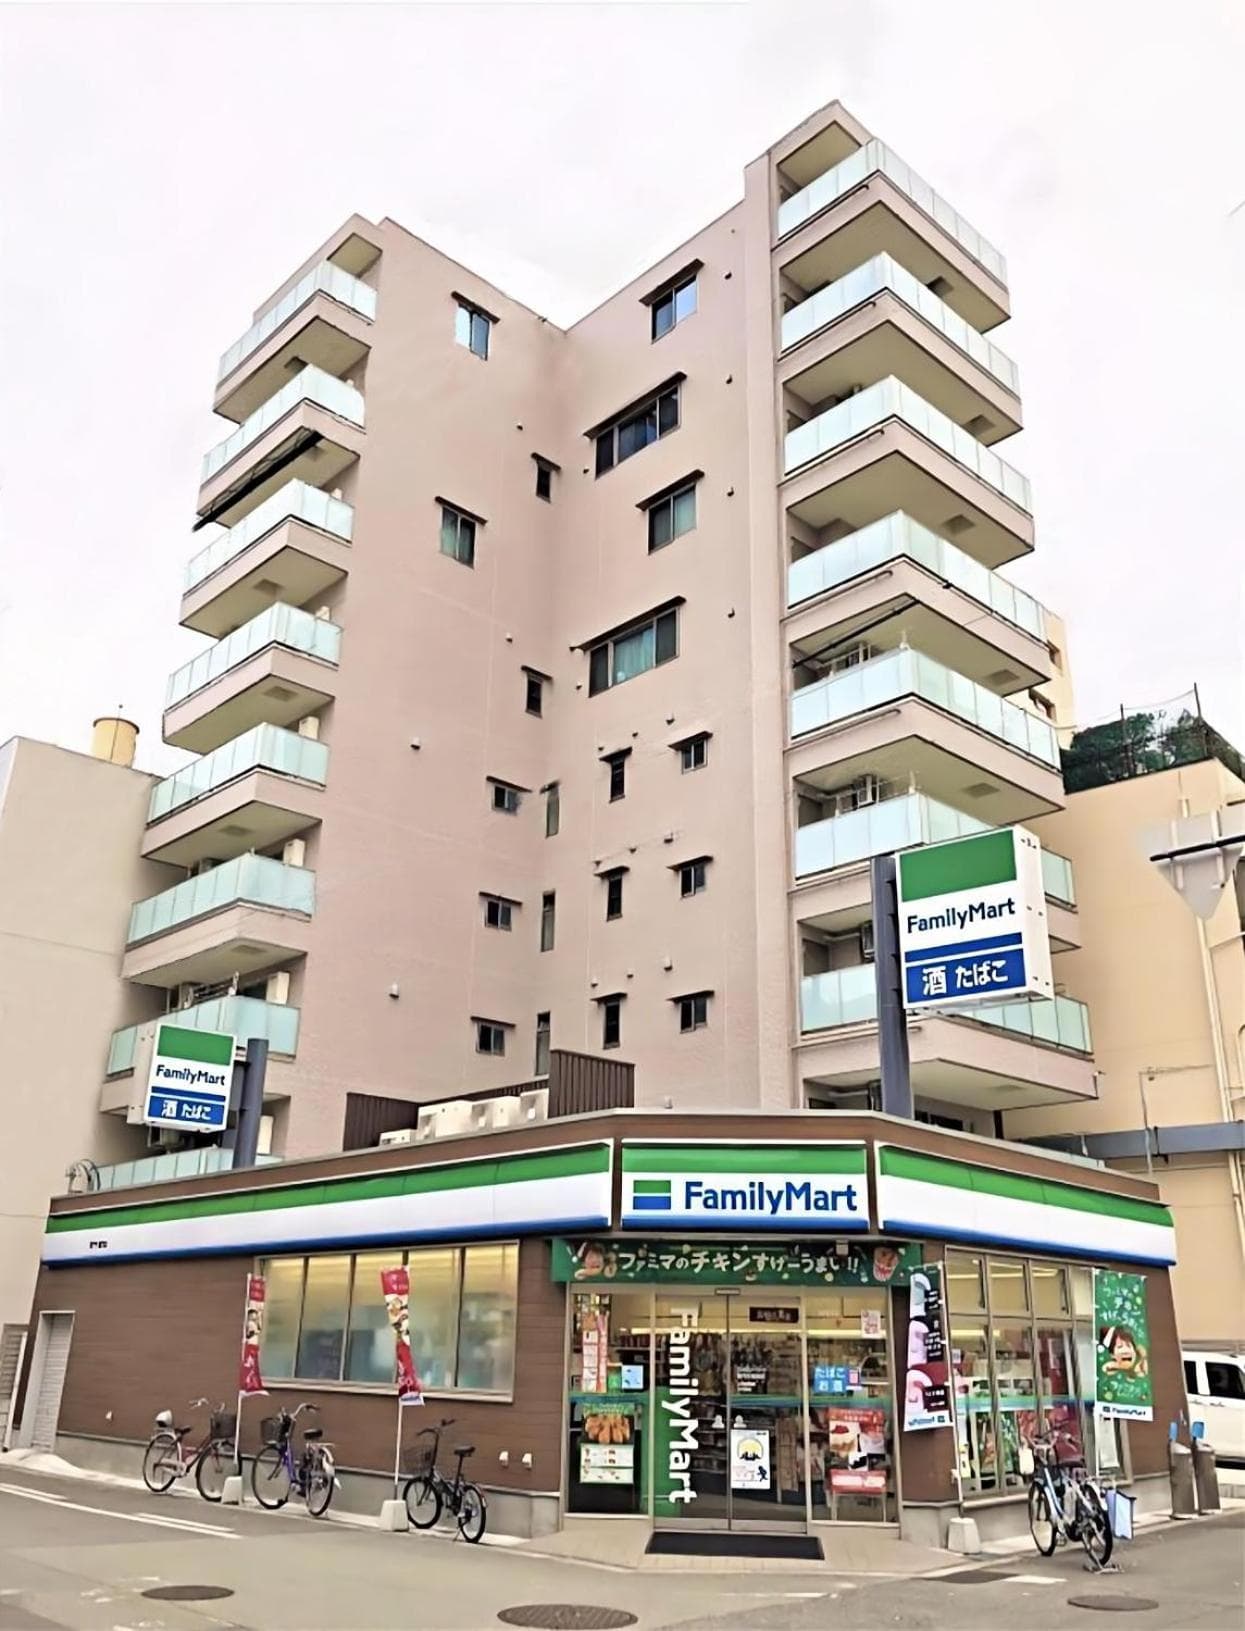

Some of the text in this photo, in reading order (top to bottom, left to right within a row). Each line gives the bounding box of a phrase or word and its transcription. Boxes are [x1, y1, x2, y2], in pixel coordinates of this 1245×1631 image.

[907, 898, 1016, 934] FamilyMart
[922, 959, 1009, 996] 酒 たばこ
[155, 1064, 226, 1086] FamilyMart
[685, 1181, 858, 1215] FamilyMart
[661, 1307, 699, 1503] FamilyMart
